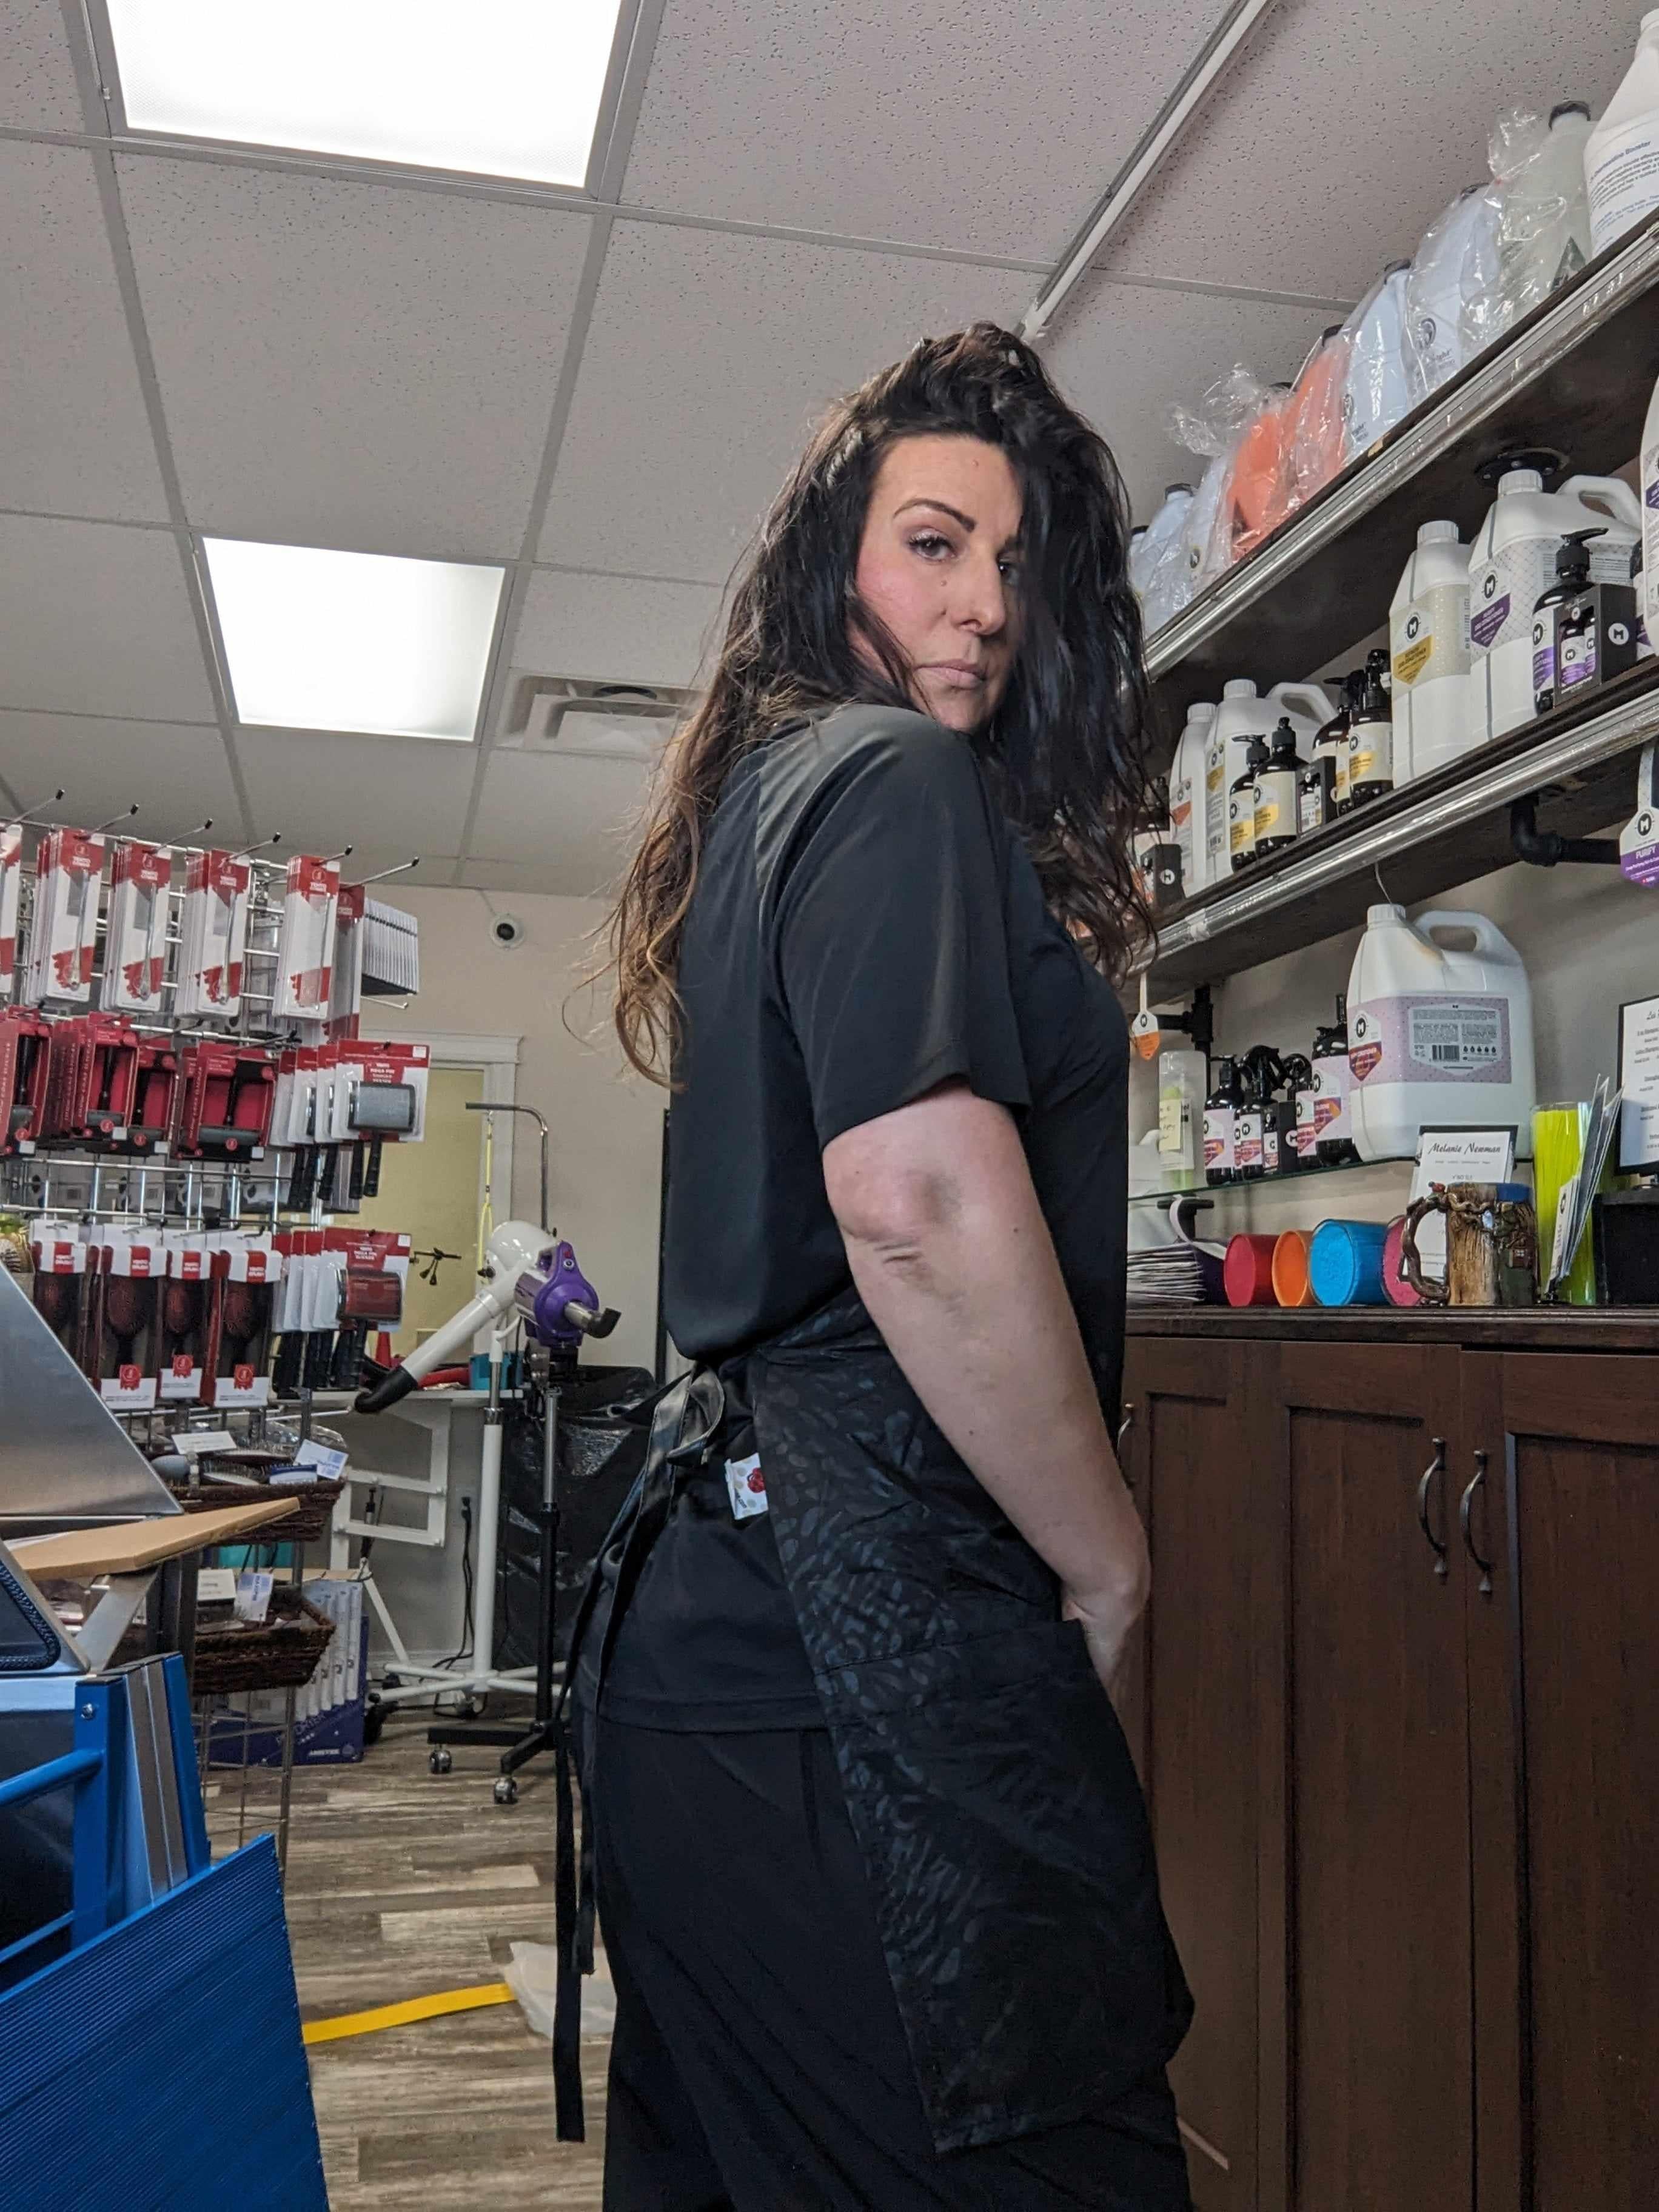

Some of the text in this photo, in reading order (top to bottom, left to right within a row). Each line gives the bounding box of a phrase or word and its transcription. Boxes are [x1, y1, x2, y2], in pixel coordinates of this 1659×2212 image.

[1614, 629, 1624, 640] M
[1428, 1142, 1501, 1155] Melanie Newman
